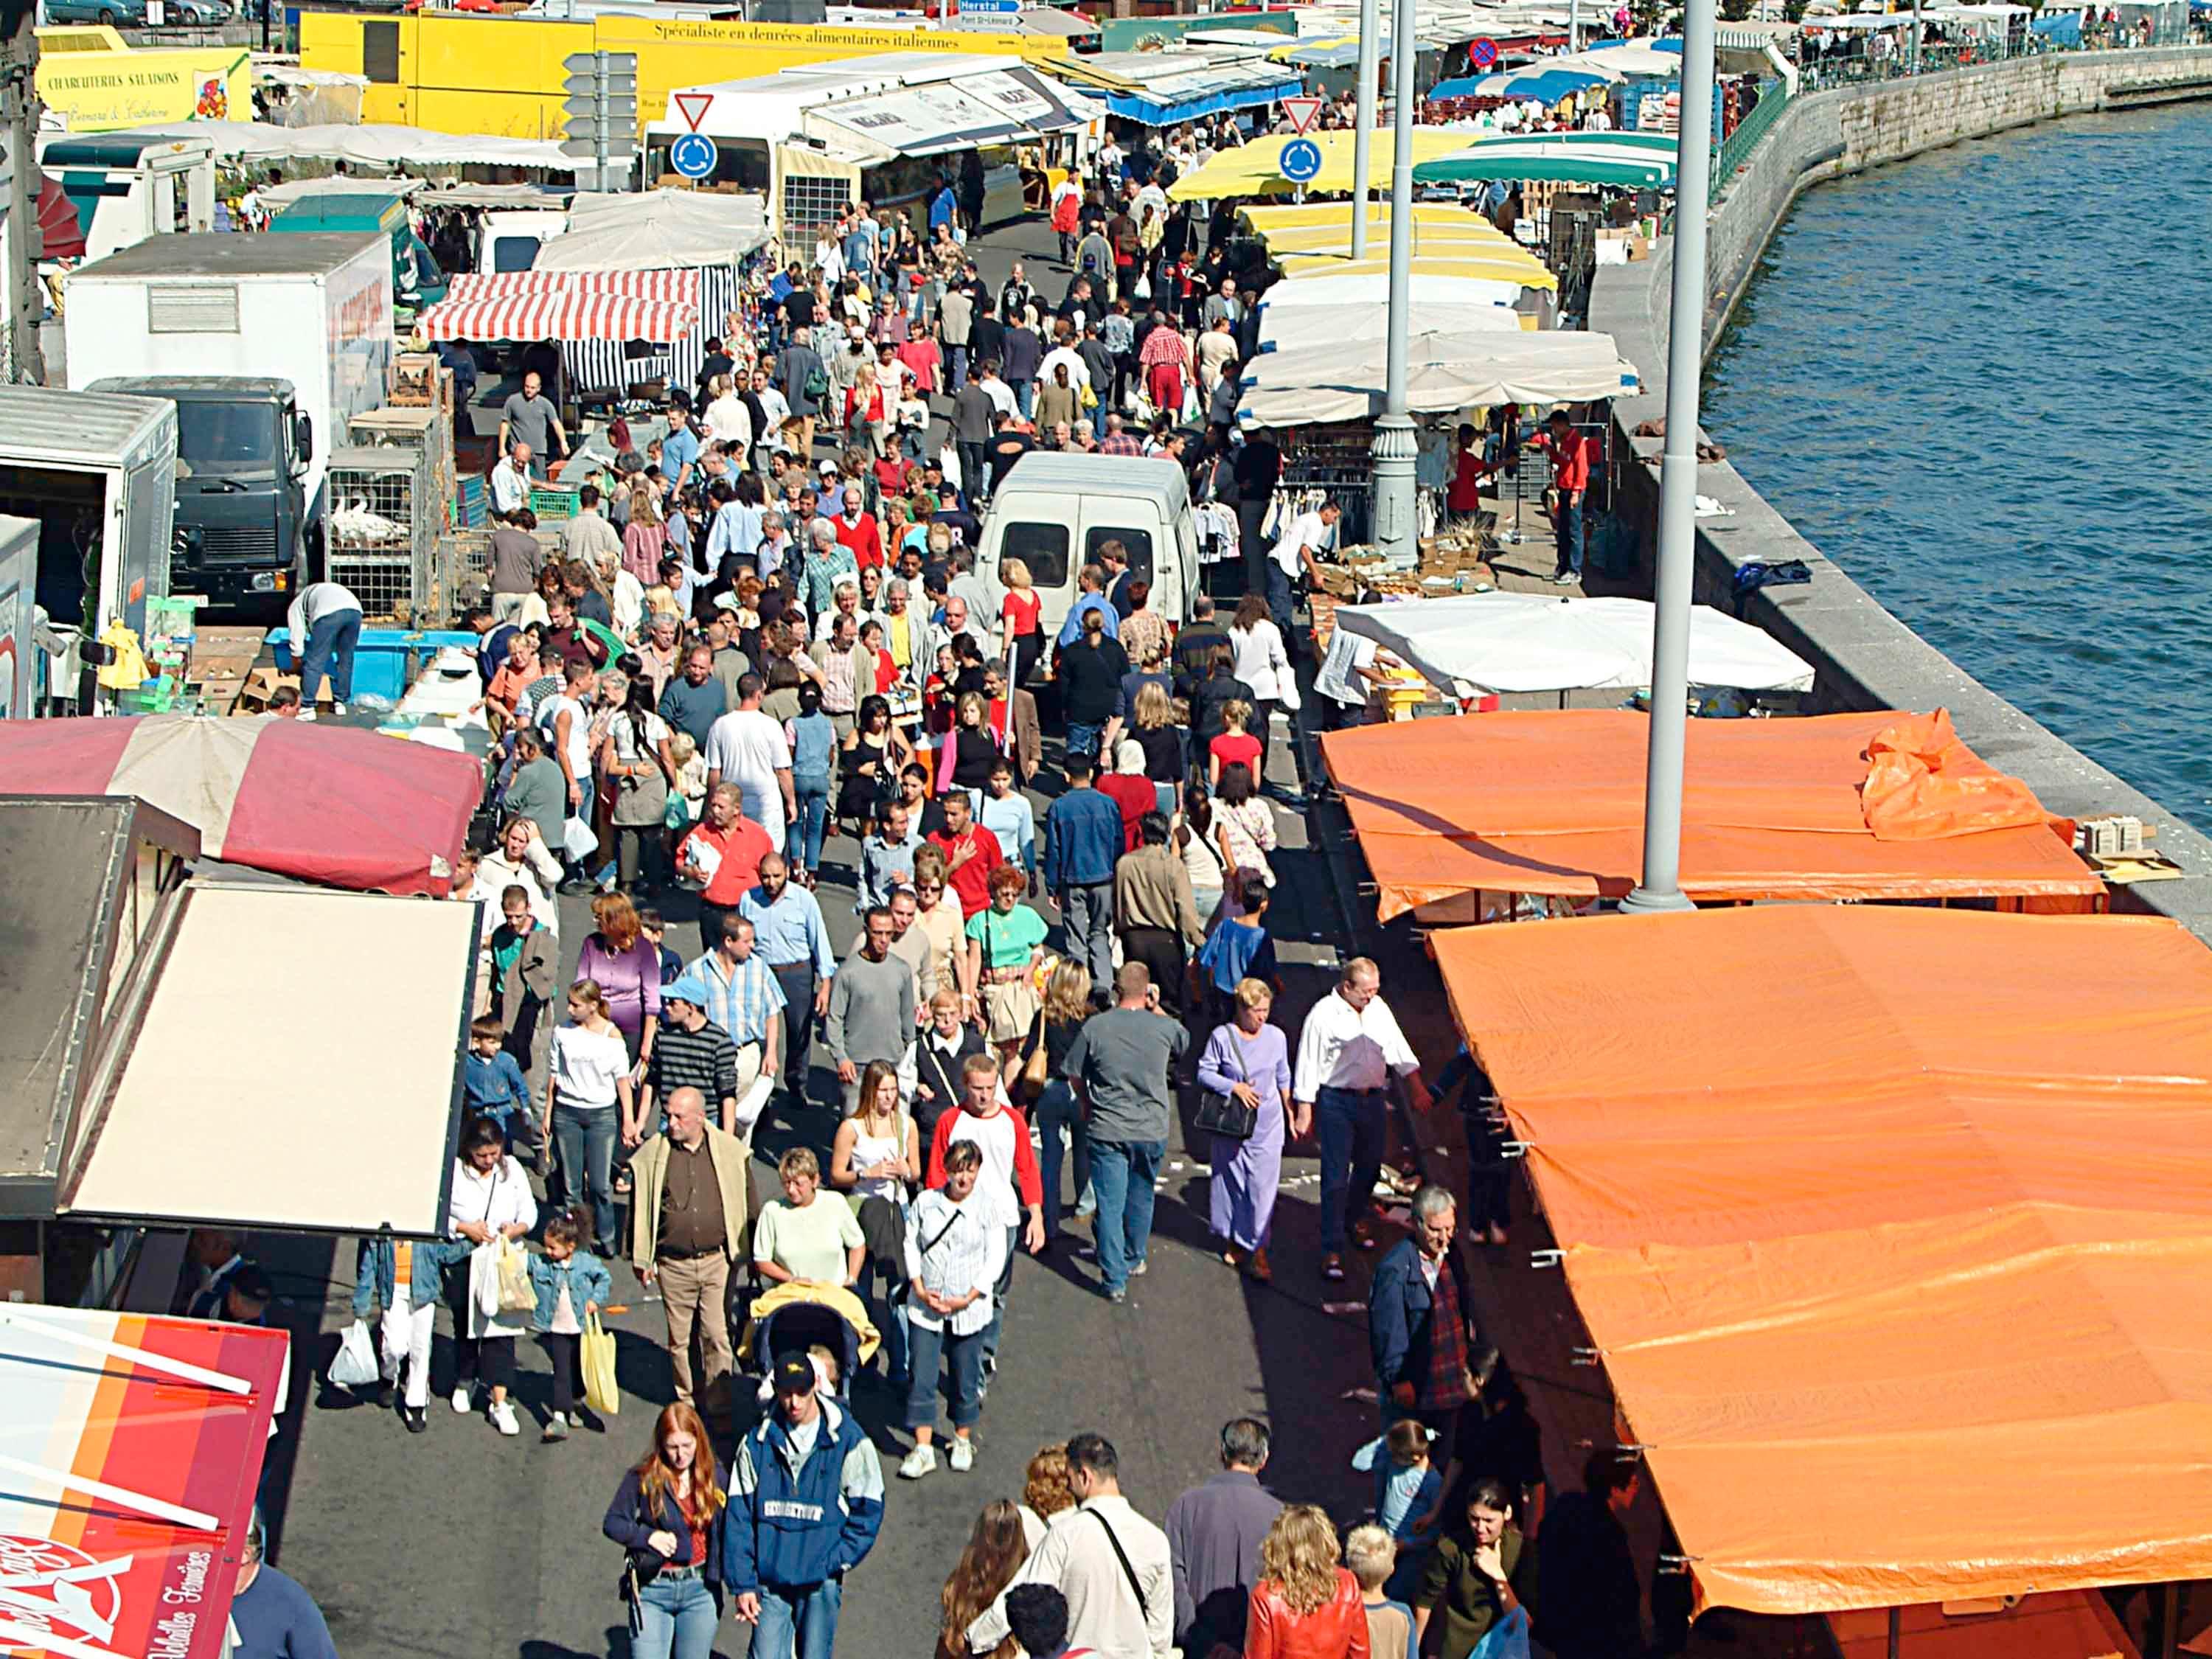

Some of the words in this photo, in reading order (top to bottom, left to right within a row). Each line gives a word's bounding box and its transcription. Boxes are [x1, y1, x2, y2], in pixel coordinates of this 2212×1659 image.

[961, 1, 1000, 10] Herstal
[654, 23, 726, 40] Spécialiste
[728, 28, 745, 39] en
[749, 27, 802, 42] denrées
[805, 29, 889, 46] alimentaires
[893, 32, 959, 49] italiennes
[48, 74, 124, 90] CHARCUTERIES
[128, 72, 179, 87] SALAISONS
